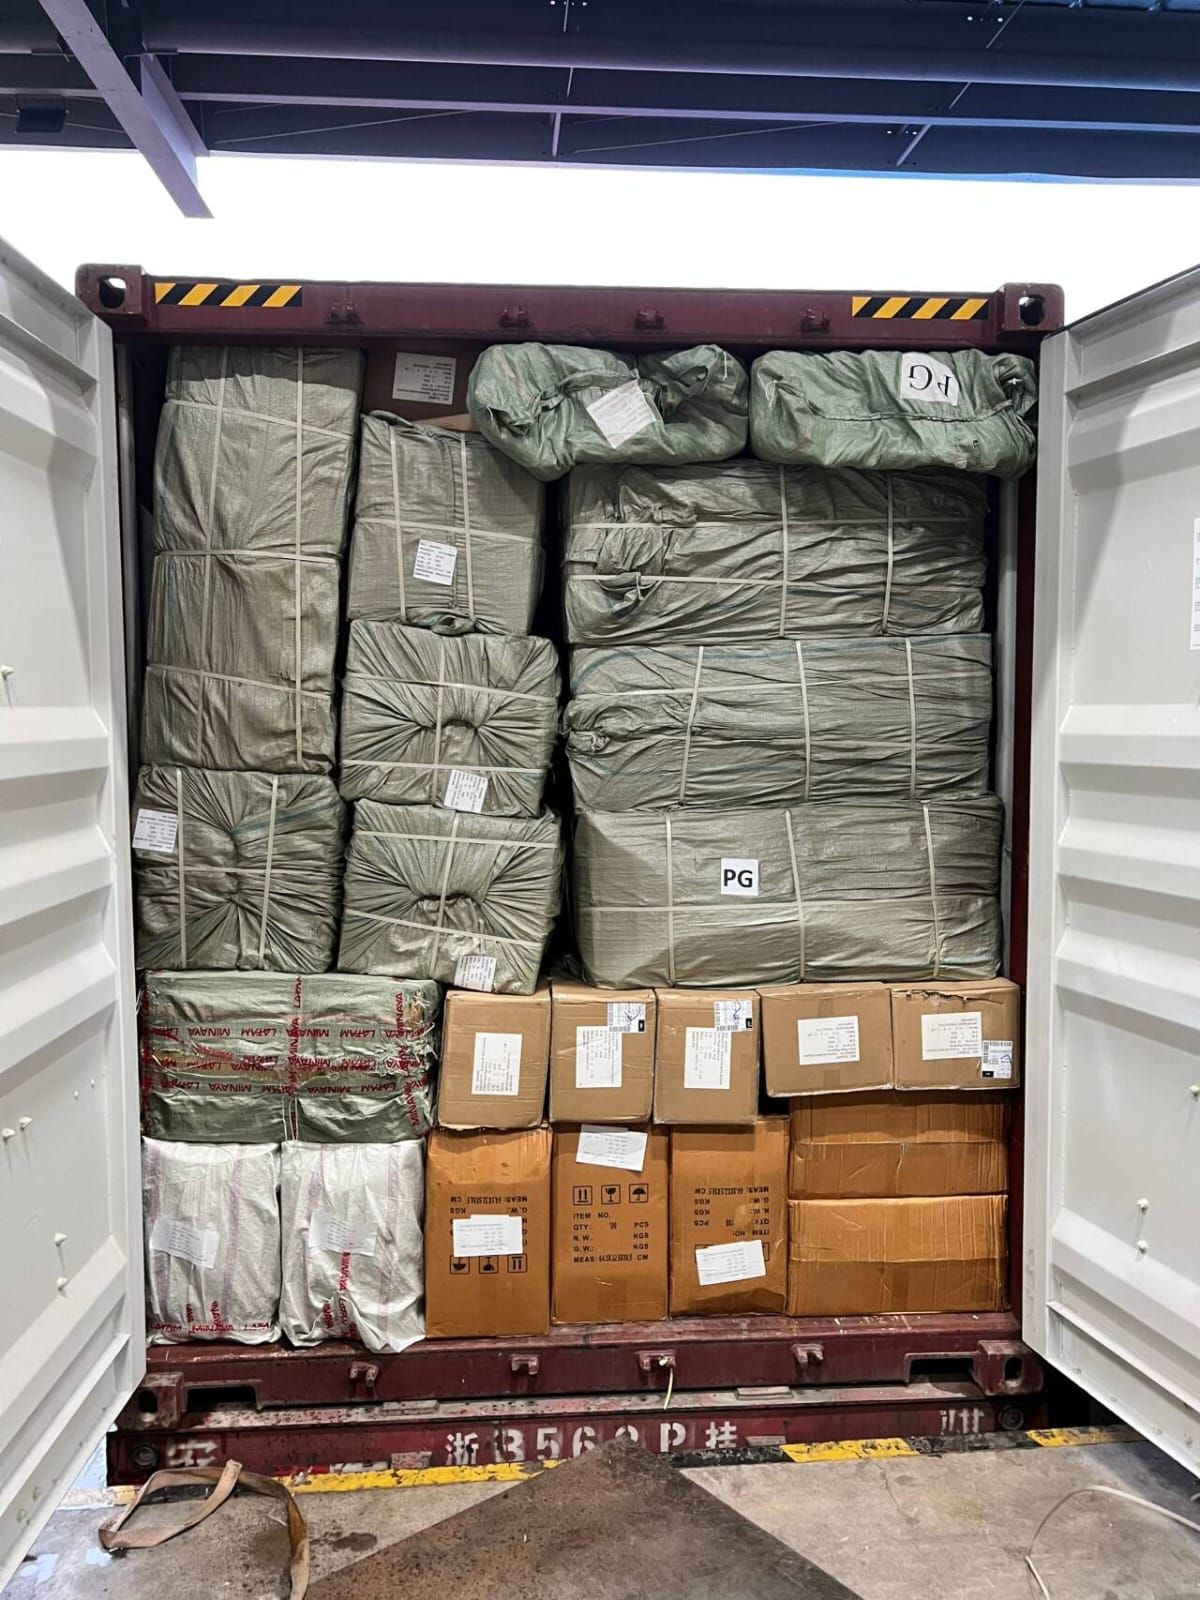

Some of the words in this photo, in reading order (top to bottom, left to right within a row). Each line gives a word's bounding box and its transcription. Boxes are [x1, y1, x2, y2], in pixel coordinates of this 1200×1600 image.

[723, 868, 753, 888] PG
[188, 1028, 231, 1037] MINAYA
[241, 1028, 277, 1037] LATAM
[208, 1082, 252, 1092] MINAYA
[306, 1086, 351, 1095] MINAYA
[694, 1187, 706, 1195] CM
[572, 1212, 591, 1220] ITEM
[694, 1219, 709, 1227] PCS
[632, 1231, 649, 1239] KGS
[751, 1228, 770, 1236] ITEM
